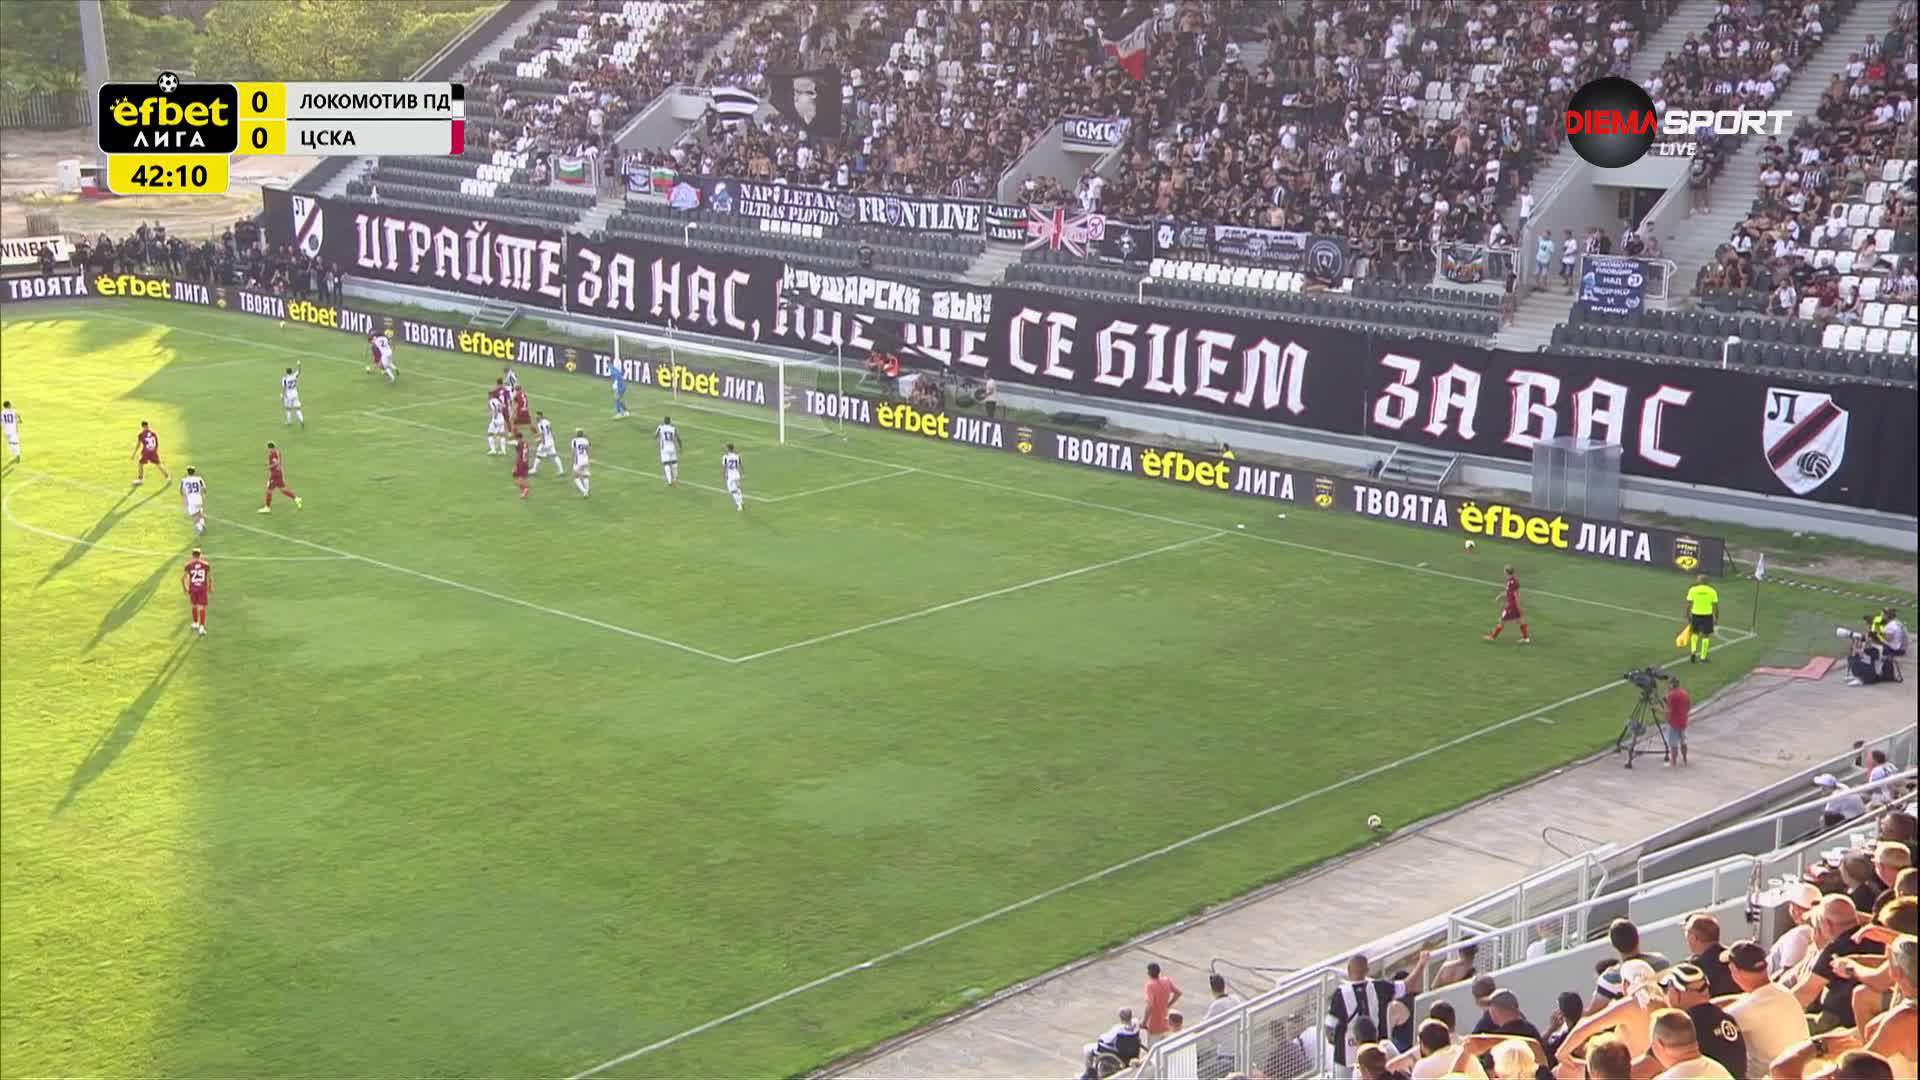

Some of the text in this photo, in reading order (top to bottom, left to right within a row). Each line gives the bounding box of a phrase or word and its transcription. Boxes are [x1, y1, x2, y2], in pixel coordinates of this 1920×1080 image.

[740, 200, 785, 219] ULTRAS
[988, 204, 1027, 218] LAUTA
[9, 275, 209, 305] ТВОЯТА efbet ЛИГА
[239, 292, 373, 334] ТВОЯТА efbet ЛИГА
[403, 321, 555, 368] ТВОЯТА efbet ЛИГА
[578, 248, 635, 312] ЗА
[1009, 307, 1077, 380] СЕ
[1094, 320, 1309, 415] БИЕМ
[1373, 353, 1483, 441] ЗА
[1505, 368, 1694, 469] ВАС
[657, 365, 720, 397] efbet
[723, 376, 765, 404] ЛИГА
[805, 390, 870, 424] ТВОЯТА
[877, 402, 949, 439] efbet
[953, 417, 1003, 448] ЛИГА
[185, 481, 199, 493] 39
[1056, 434, 1133, 472] ТВОЯТА
[1141, 449, 1230, 490] efbet
[1235, 466, 1295, 500] ЛИГА
[1353, 485, 1448, 527] ТВОЯТА
[1458, 502, 1569, 549] efbet
[1575, 522, 1652, 562] ЛИГА
[191, 569, 205, 582] 29
